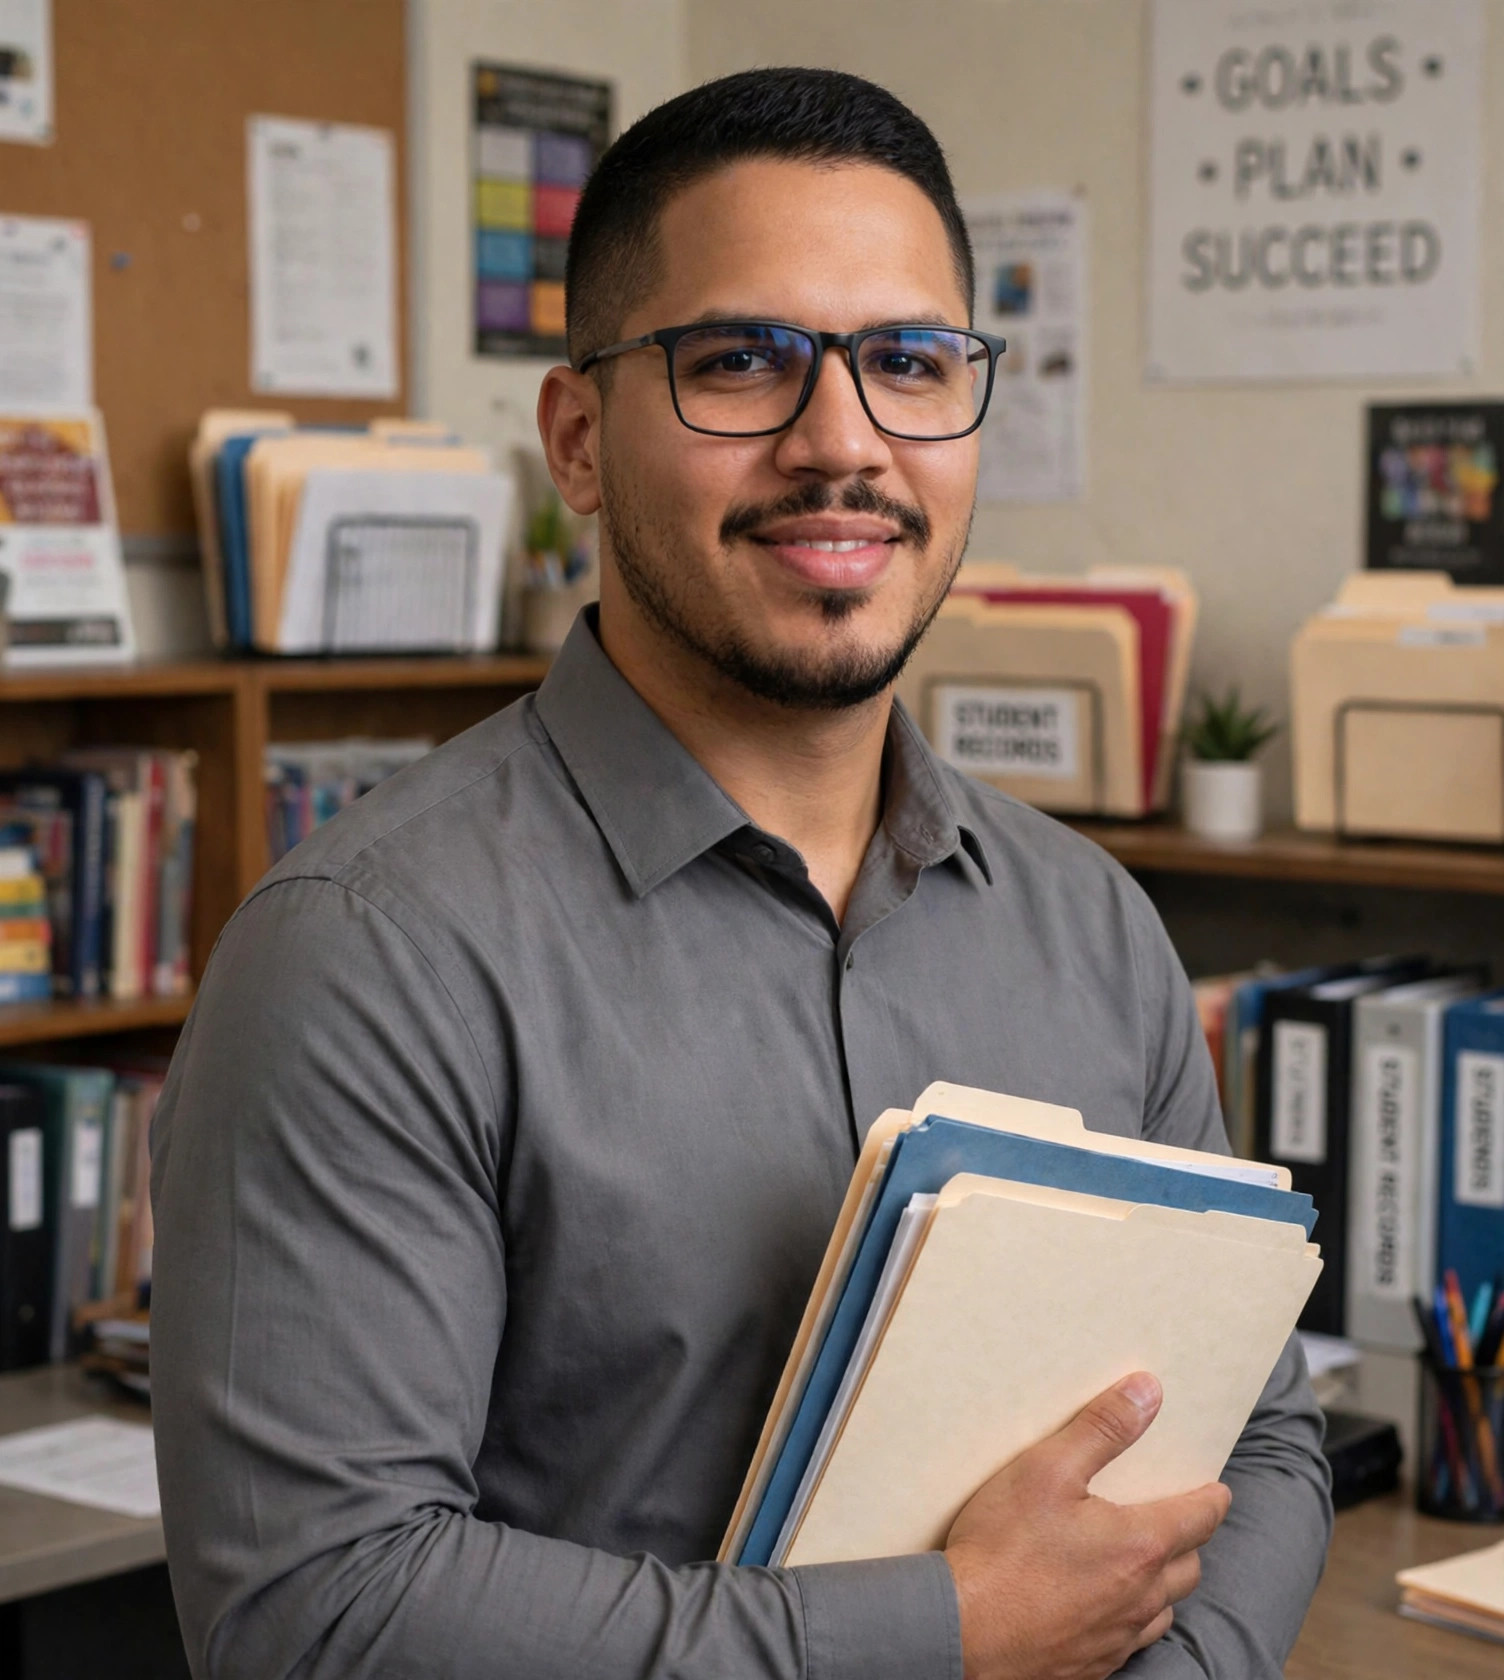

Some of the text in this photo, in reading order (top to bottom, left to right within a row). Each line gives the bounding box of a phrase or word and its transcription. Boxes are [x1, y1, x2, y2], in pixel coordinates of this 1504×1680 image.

[1214, 34, 1405, 113] GOALS
[1233, 132, 1383, 202] PLAN
[1180, 219, 1442, 293] SUCCEED
[953, 699, 1059, 729] STUDENT
[953, 734, 1062, 766] RECORDS
[1374, 1057, 1402, 1287] STUDENT RECORDS
